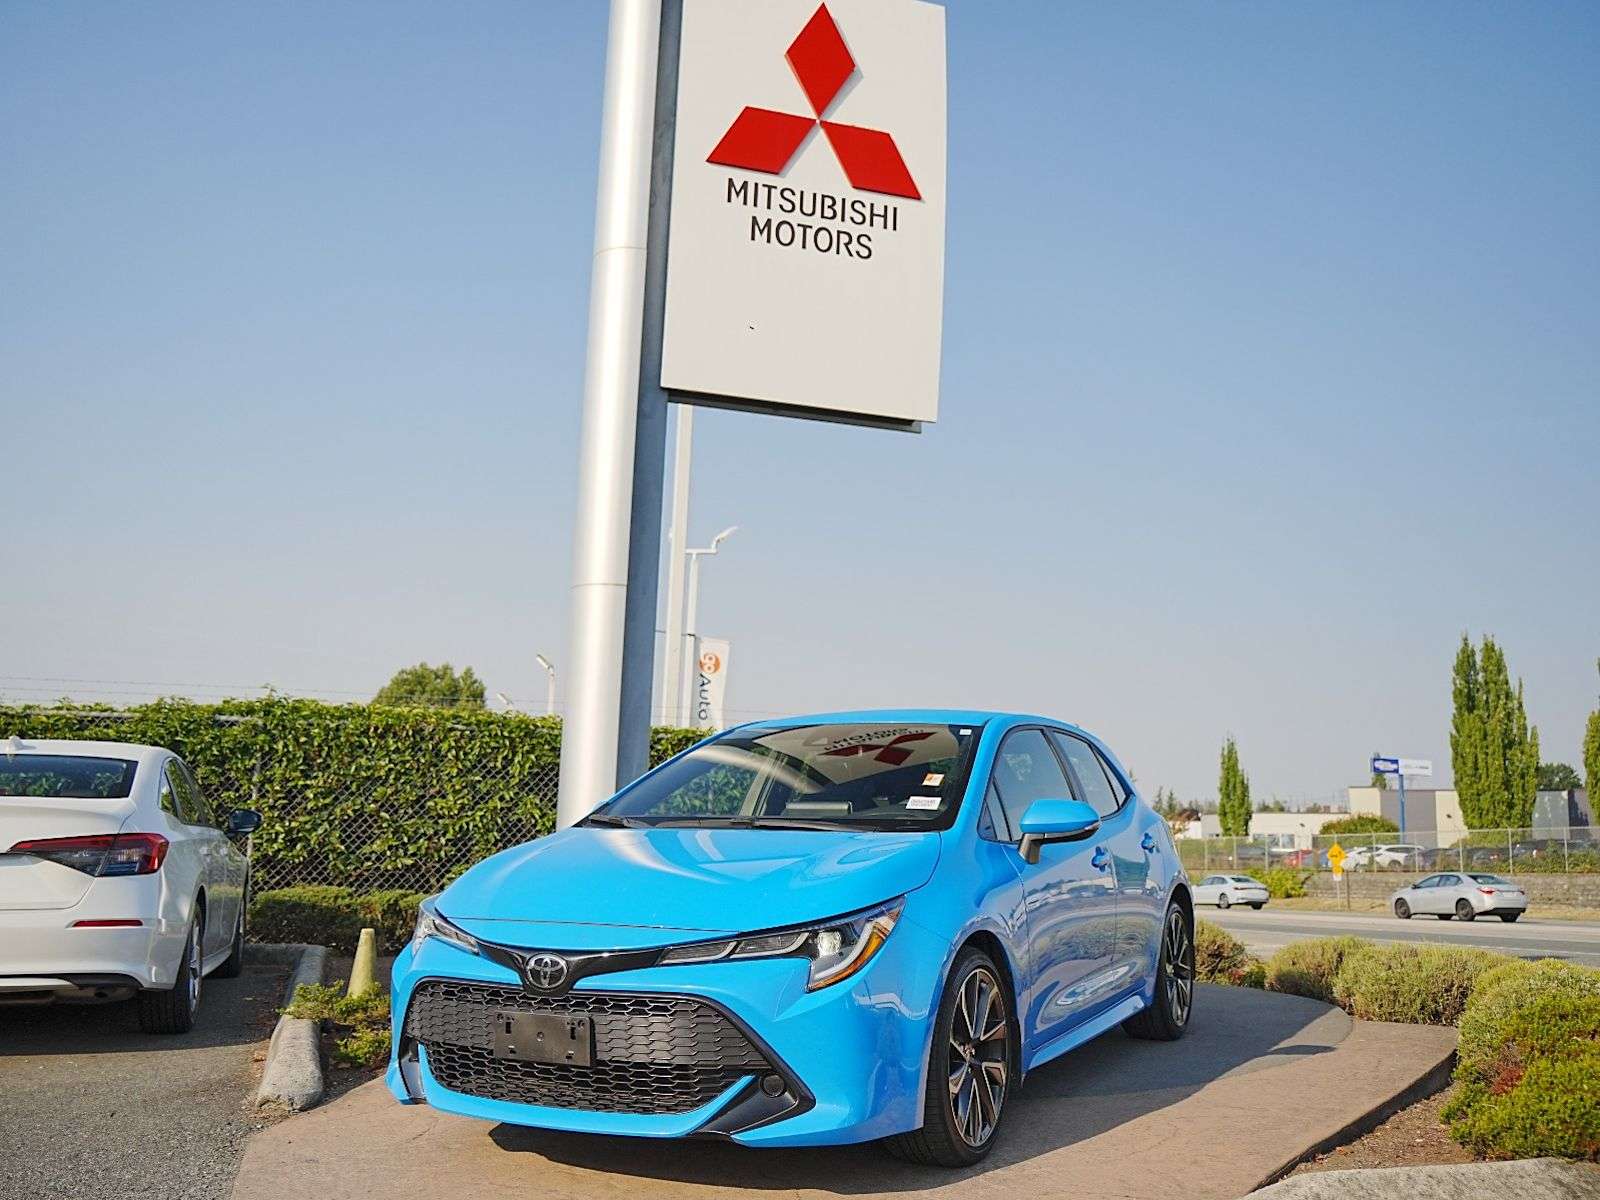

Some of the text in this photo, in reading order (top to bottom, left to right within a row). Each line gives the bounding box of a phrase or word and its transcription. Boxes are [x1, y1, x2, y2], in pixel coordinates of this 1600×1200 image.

[727, 177, 898, 231] MITSUBISHI
[751, 215, 872, 259] MOTORS
[698, 672, 711, 720] Auto
